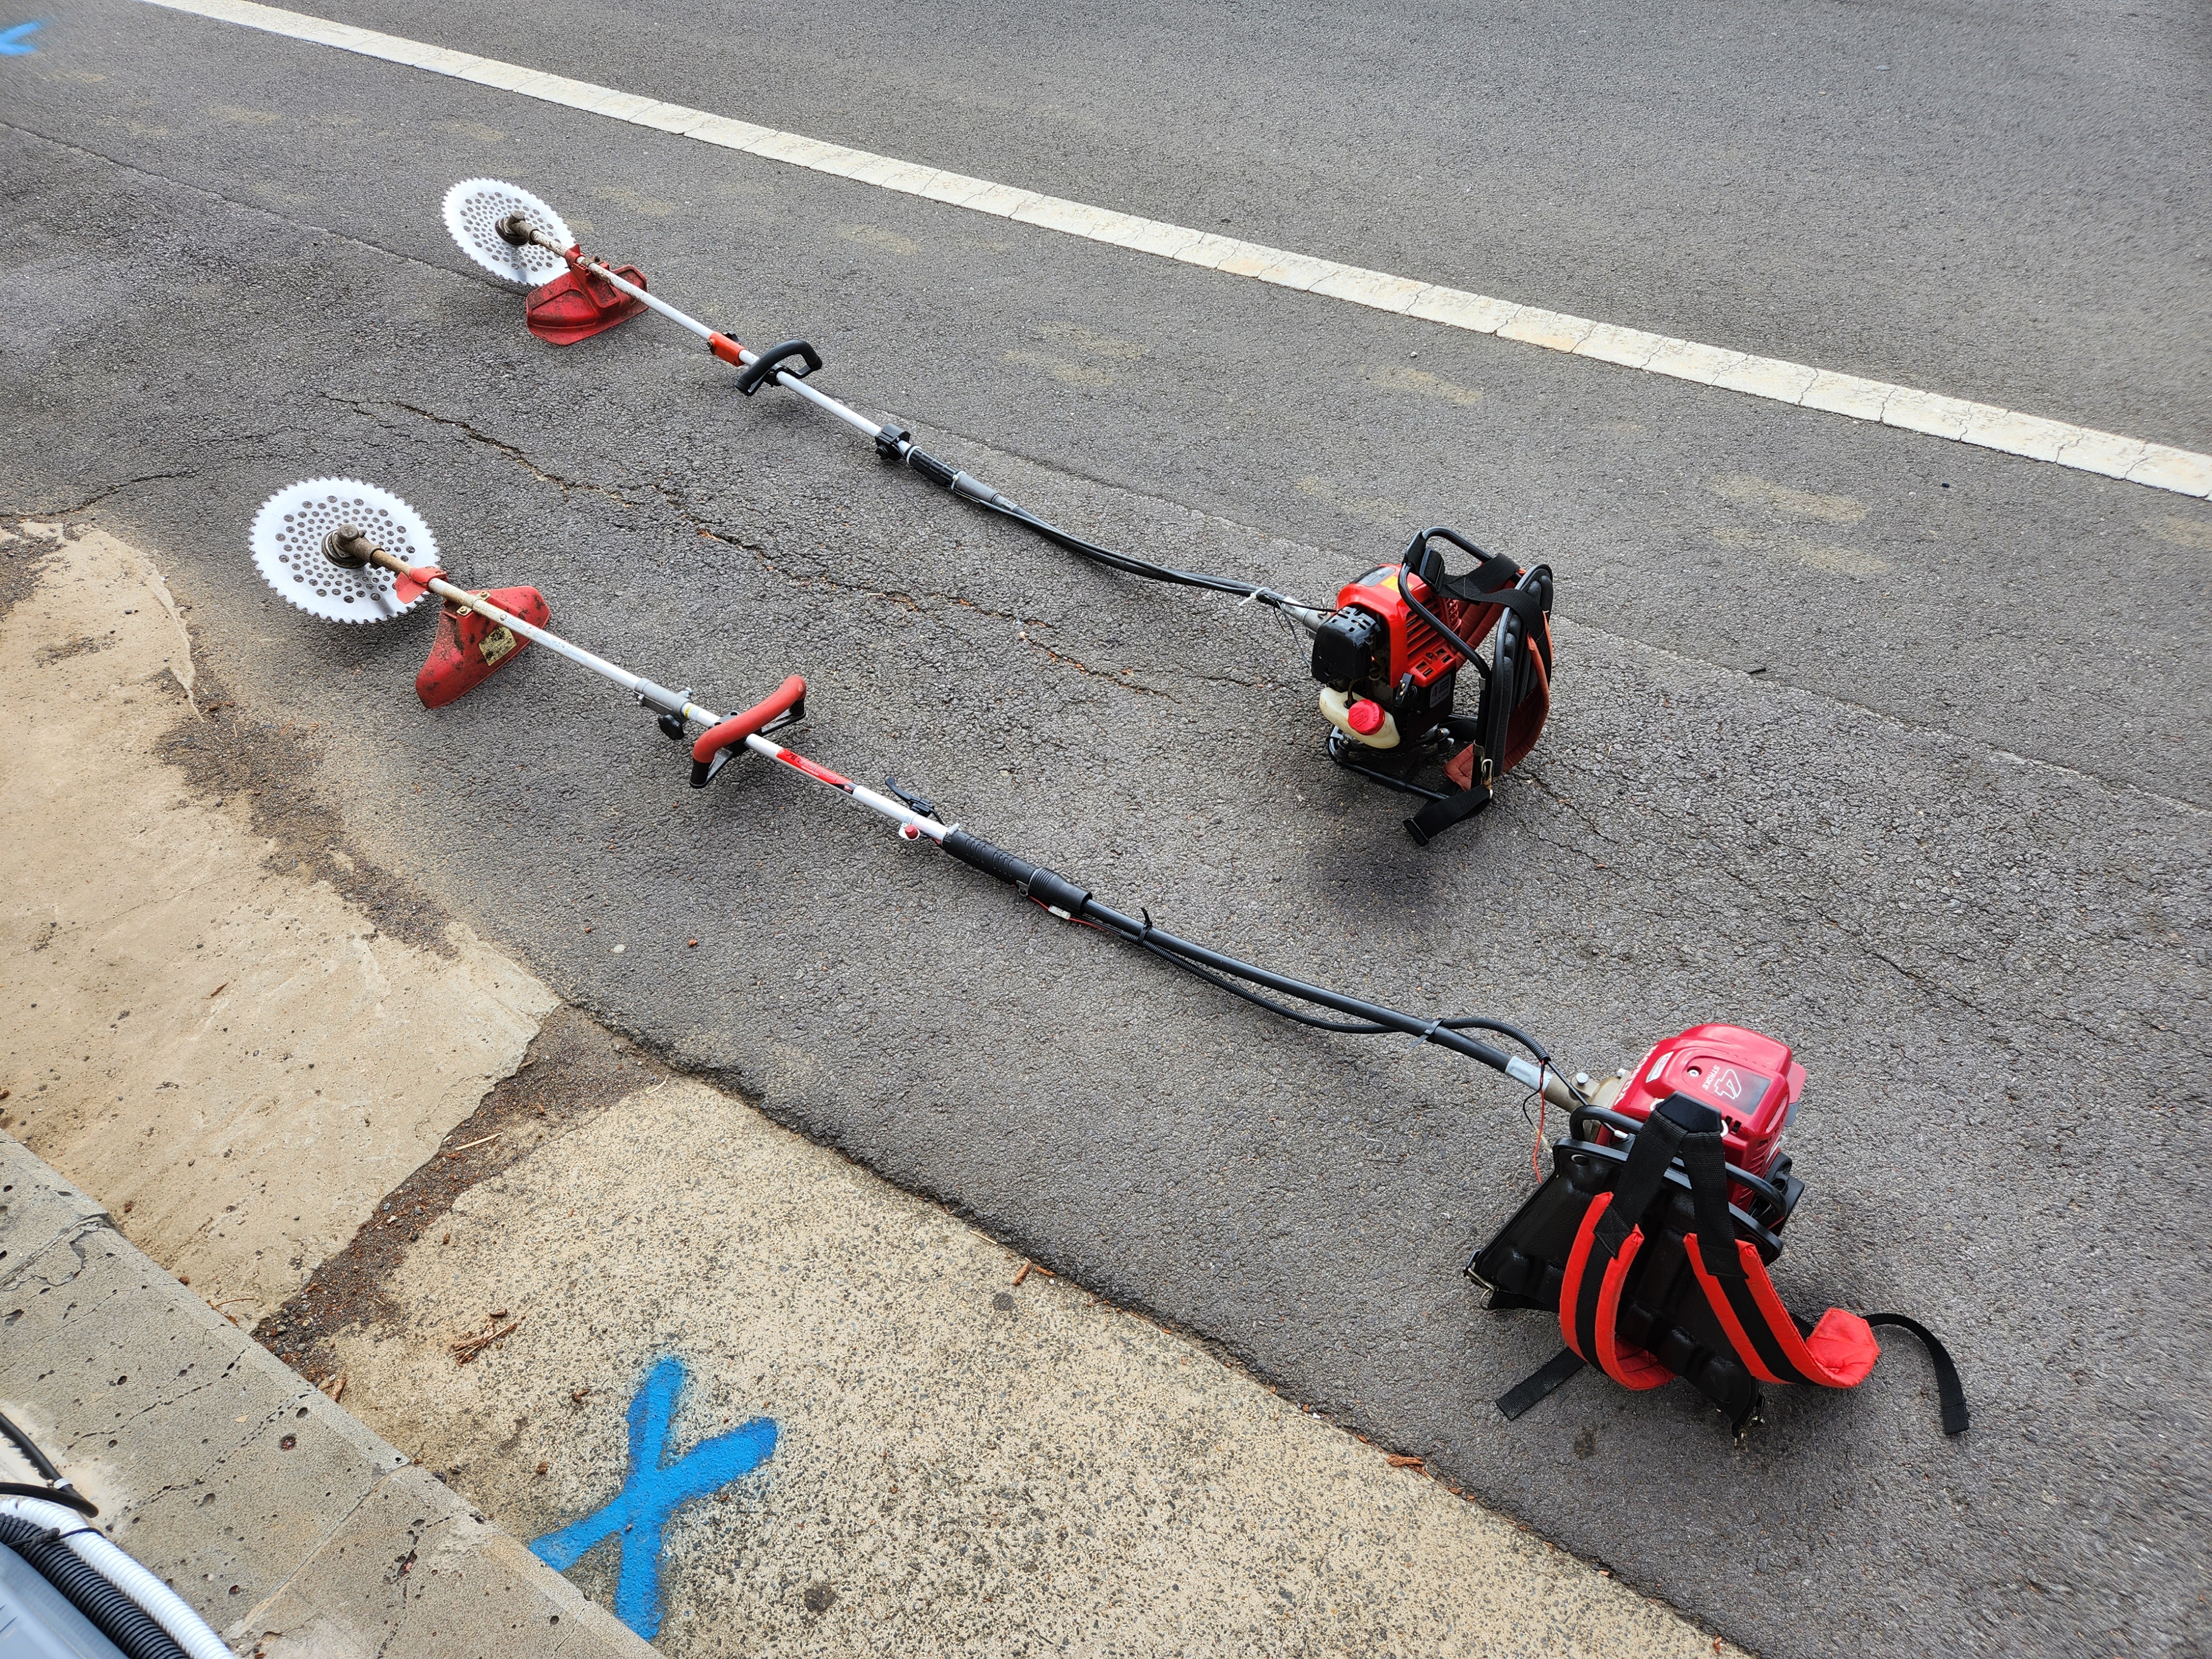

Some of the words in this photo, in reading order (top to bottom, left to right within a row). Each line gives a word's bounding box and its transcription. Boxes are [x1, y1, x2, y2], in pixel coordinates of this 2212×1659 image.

[1614, 1044, 1658, 1106] HONDA
[1702, 1065, 1720, 1091] STROKE
[1714, 1068, 1742, 1100] 4
